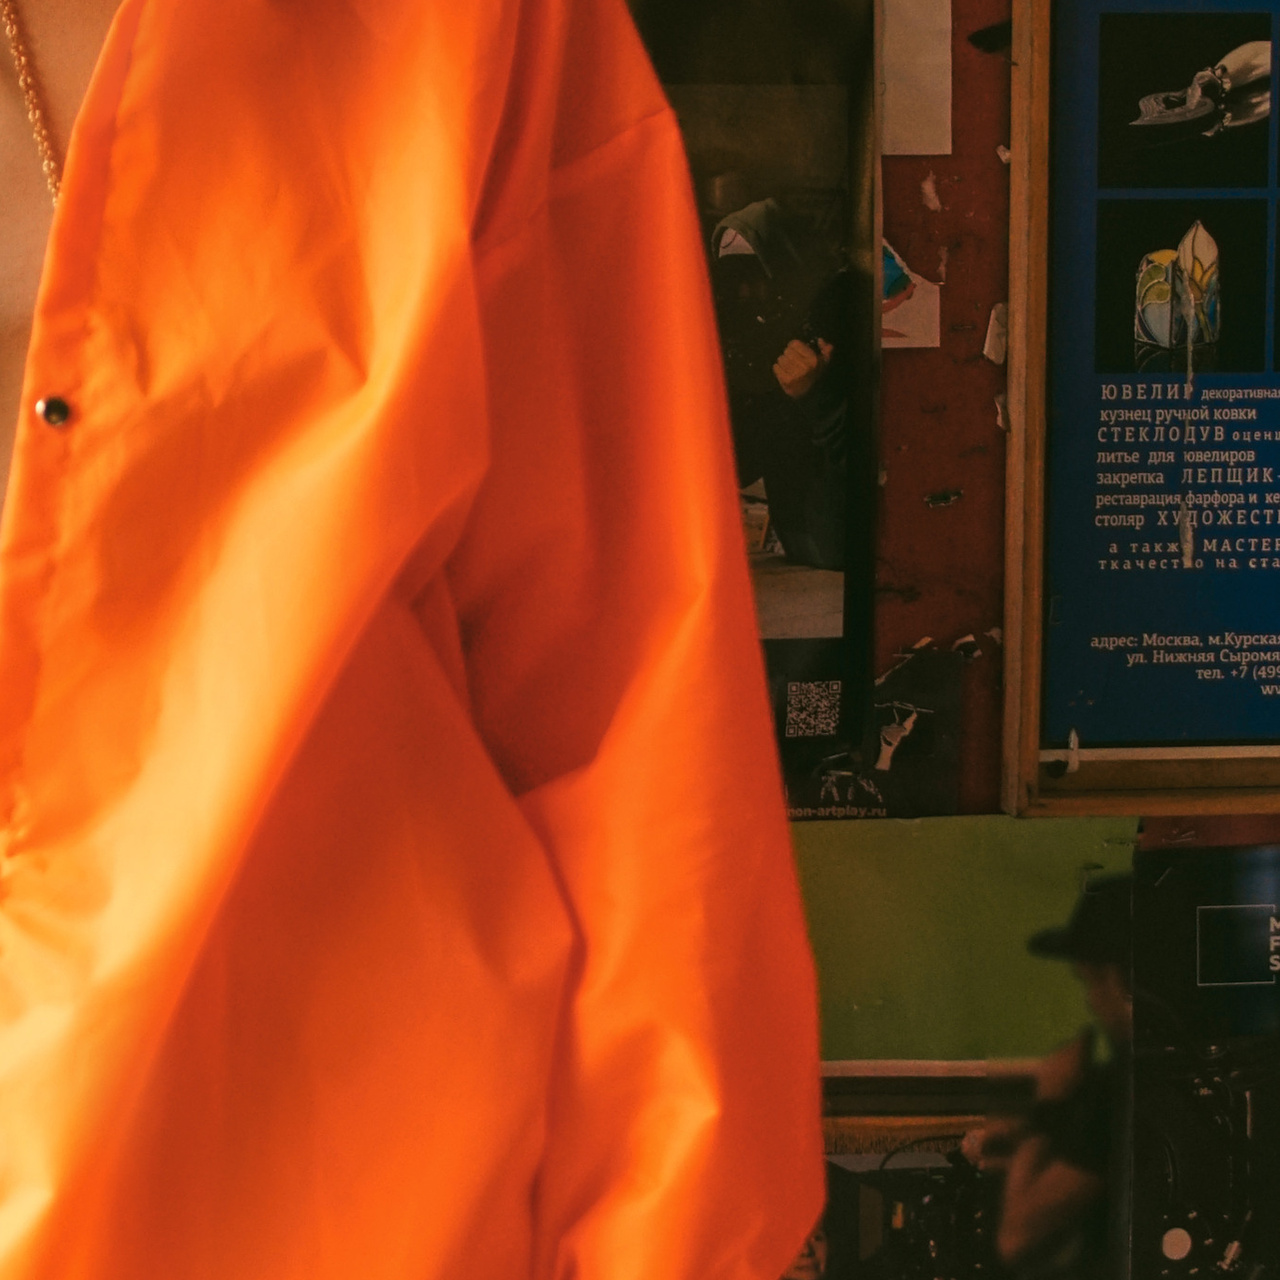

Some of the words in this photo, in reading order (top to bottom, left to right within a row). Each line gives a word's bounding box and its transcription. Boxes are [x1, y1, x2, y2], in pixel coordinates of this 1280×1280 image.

[1100, 408, 1152, 425] кузнец
[1155, 406, 1210, 425] ручной
[1213, 407, 1258, 421] ковки
[1097, 426, 1226, 445] СТЕКЛОДУВ
[1096, 450, 1141, 465] литье
[1147, 450, 1176, 466] для
[1183, 449, 1257, 467] ювелиров
[1096, 471, 1165, 489] закрепка
[1095, 493, 1182, 509] реставрация
[1184, 489, 1246, 509] фарфора
[1248, 493, 1258, 504] и
[1094, 514, 1145, 531] столяр
[1215, 559, 1238, 570] на
[1090, 635, 1139, 651] адрес:
[1142, 632, 1204, 649] Москва,
[1126, 652, 1148, 668] ул.
[1152, 649, 1216, 664] Нижняя
[1195, 668, 1225, 680] тел.
[1230, 665, 1249, 680] +7
